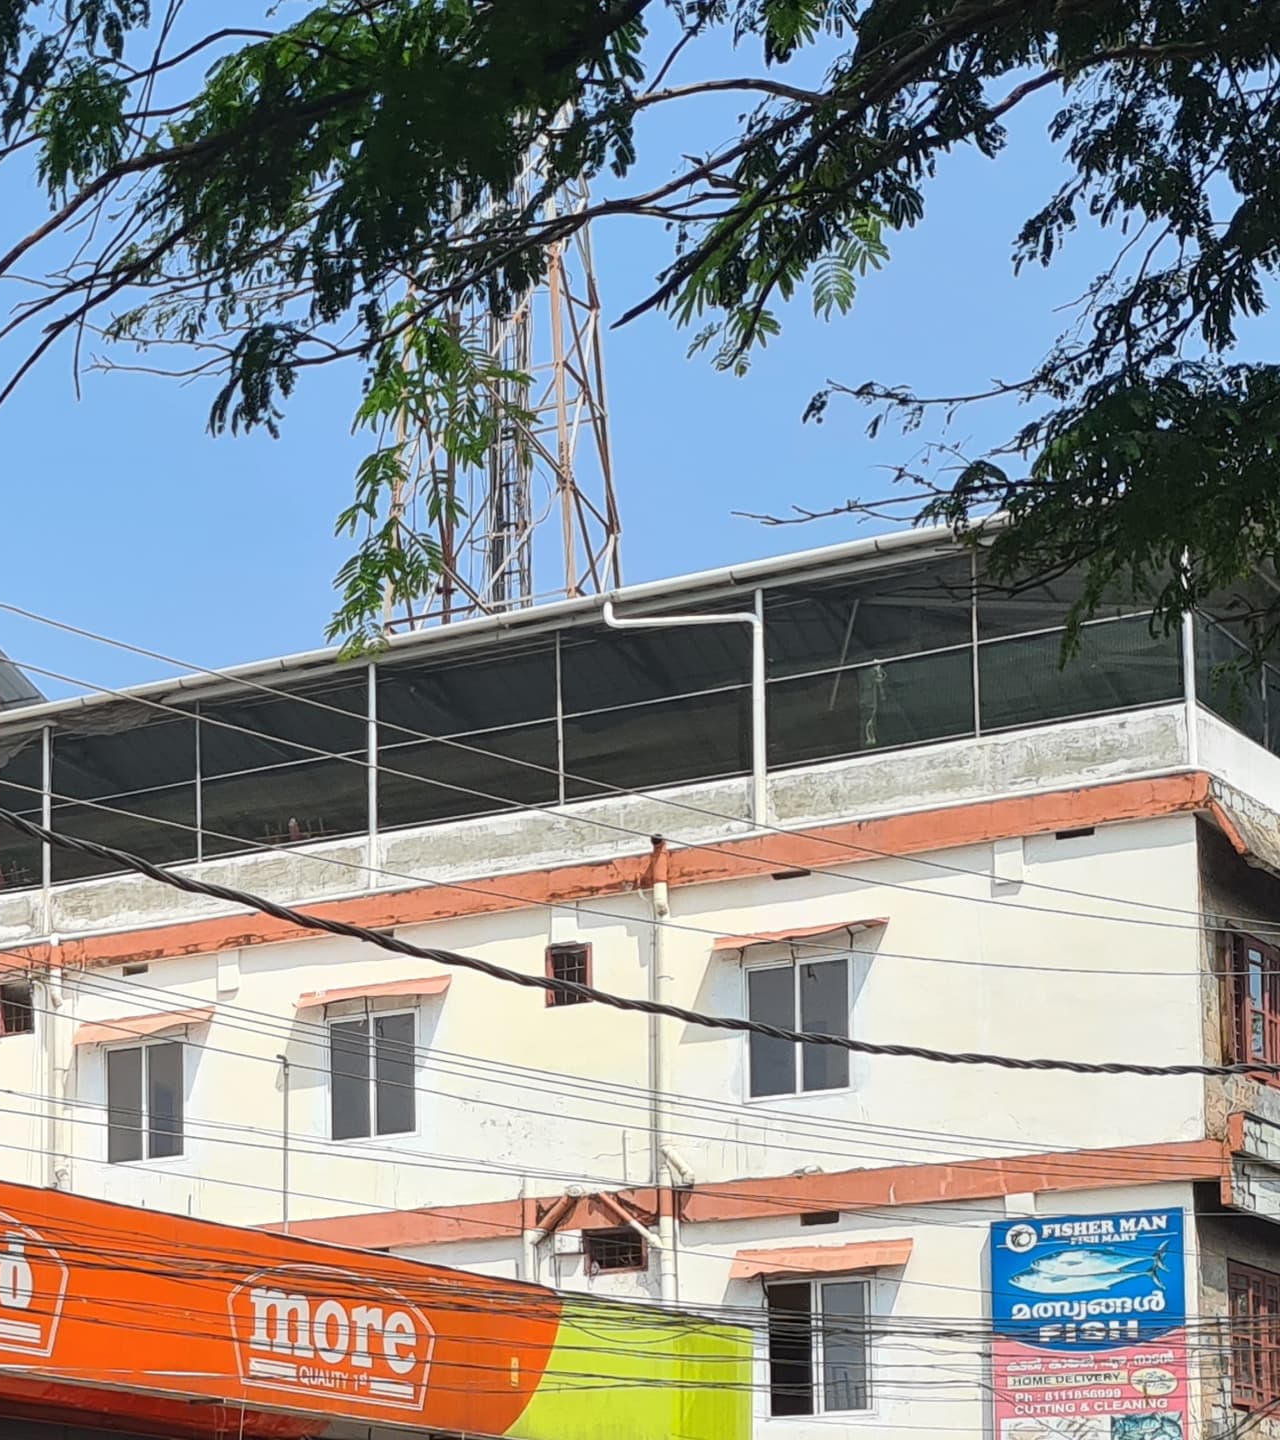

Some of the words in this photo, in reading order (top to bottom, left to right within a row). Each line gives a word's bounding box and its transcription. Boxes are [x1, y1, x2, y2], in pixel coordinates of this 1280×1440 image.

[1041, 1220, 1116, 1238] FISHER
[1119, 1215, 1168, 1233] MAN
[1101, 1233, 1138, 1243] MART
[1011, 1290, 1166, 1320] മത്സ്യങ്ങൾ
[250, 1286, 417, 1374] more
[1039, 1320, 1139, 1342] FISH
[299, 1366, 349, 1391] QUALITY
[1012, 1373, 1052, 1387] HOME
[1055, 1372, 1121, 1385] DELIVERY
[1015, 1402, 1076, 1415] CUTTING
[1080, 1402, 1090, 1412] &
[1094, 1398, 1168, 1411] CLEANING
